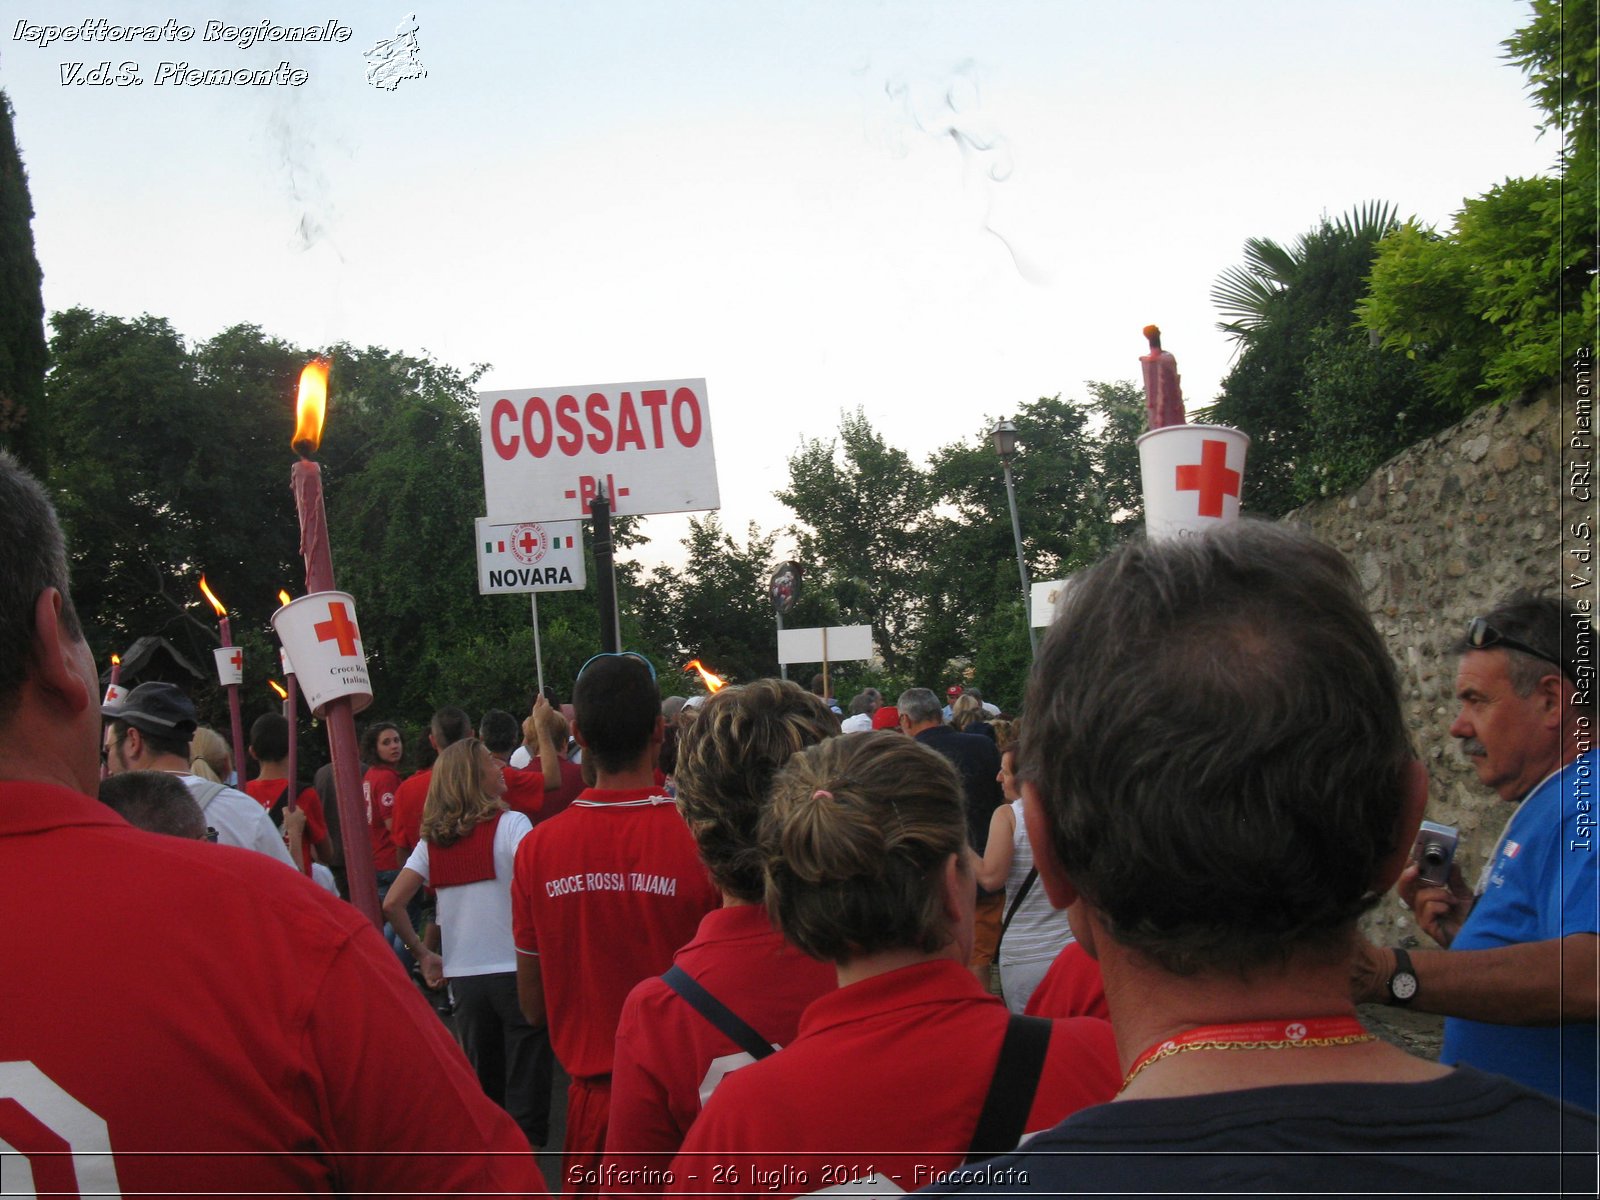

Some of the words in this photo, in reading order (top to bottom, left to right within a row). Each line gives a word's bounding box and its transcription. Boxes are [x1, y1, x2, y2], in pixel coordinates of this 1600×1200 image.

[491, 387, 702, 460] COSSATO
[489, 566, 573, 588] NOVARA
[330, 667, 354, 675] Croce
[545, 874, 585, 897] CROCE
[586, 872, 625, 891] ROSSA
[628, 873, 677, 896] ITALIANA
